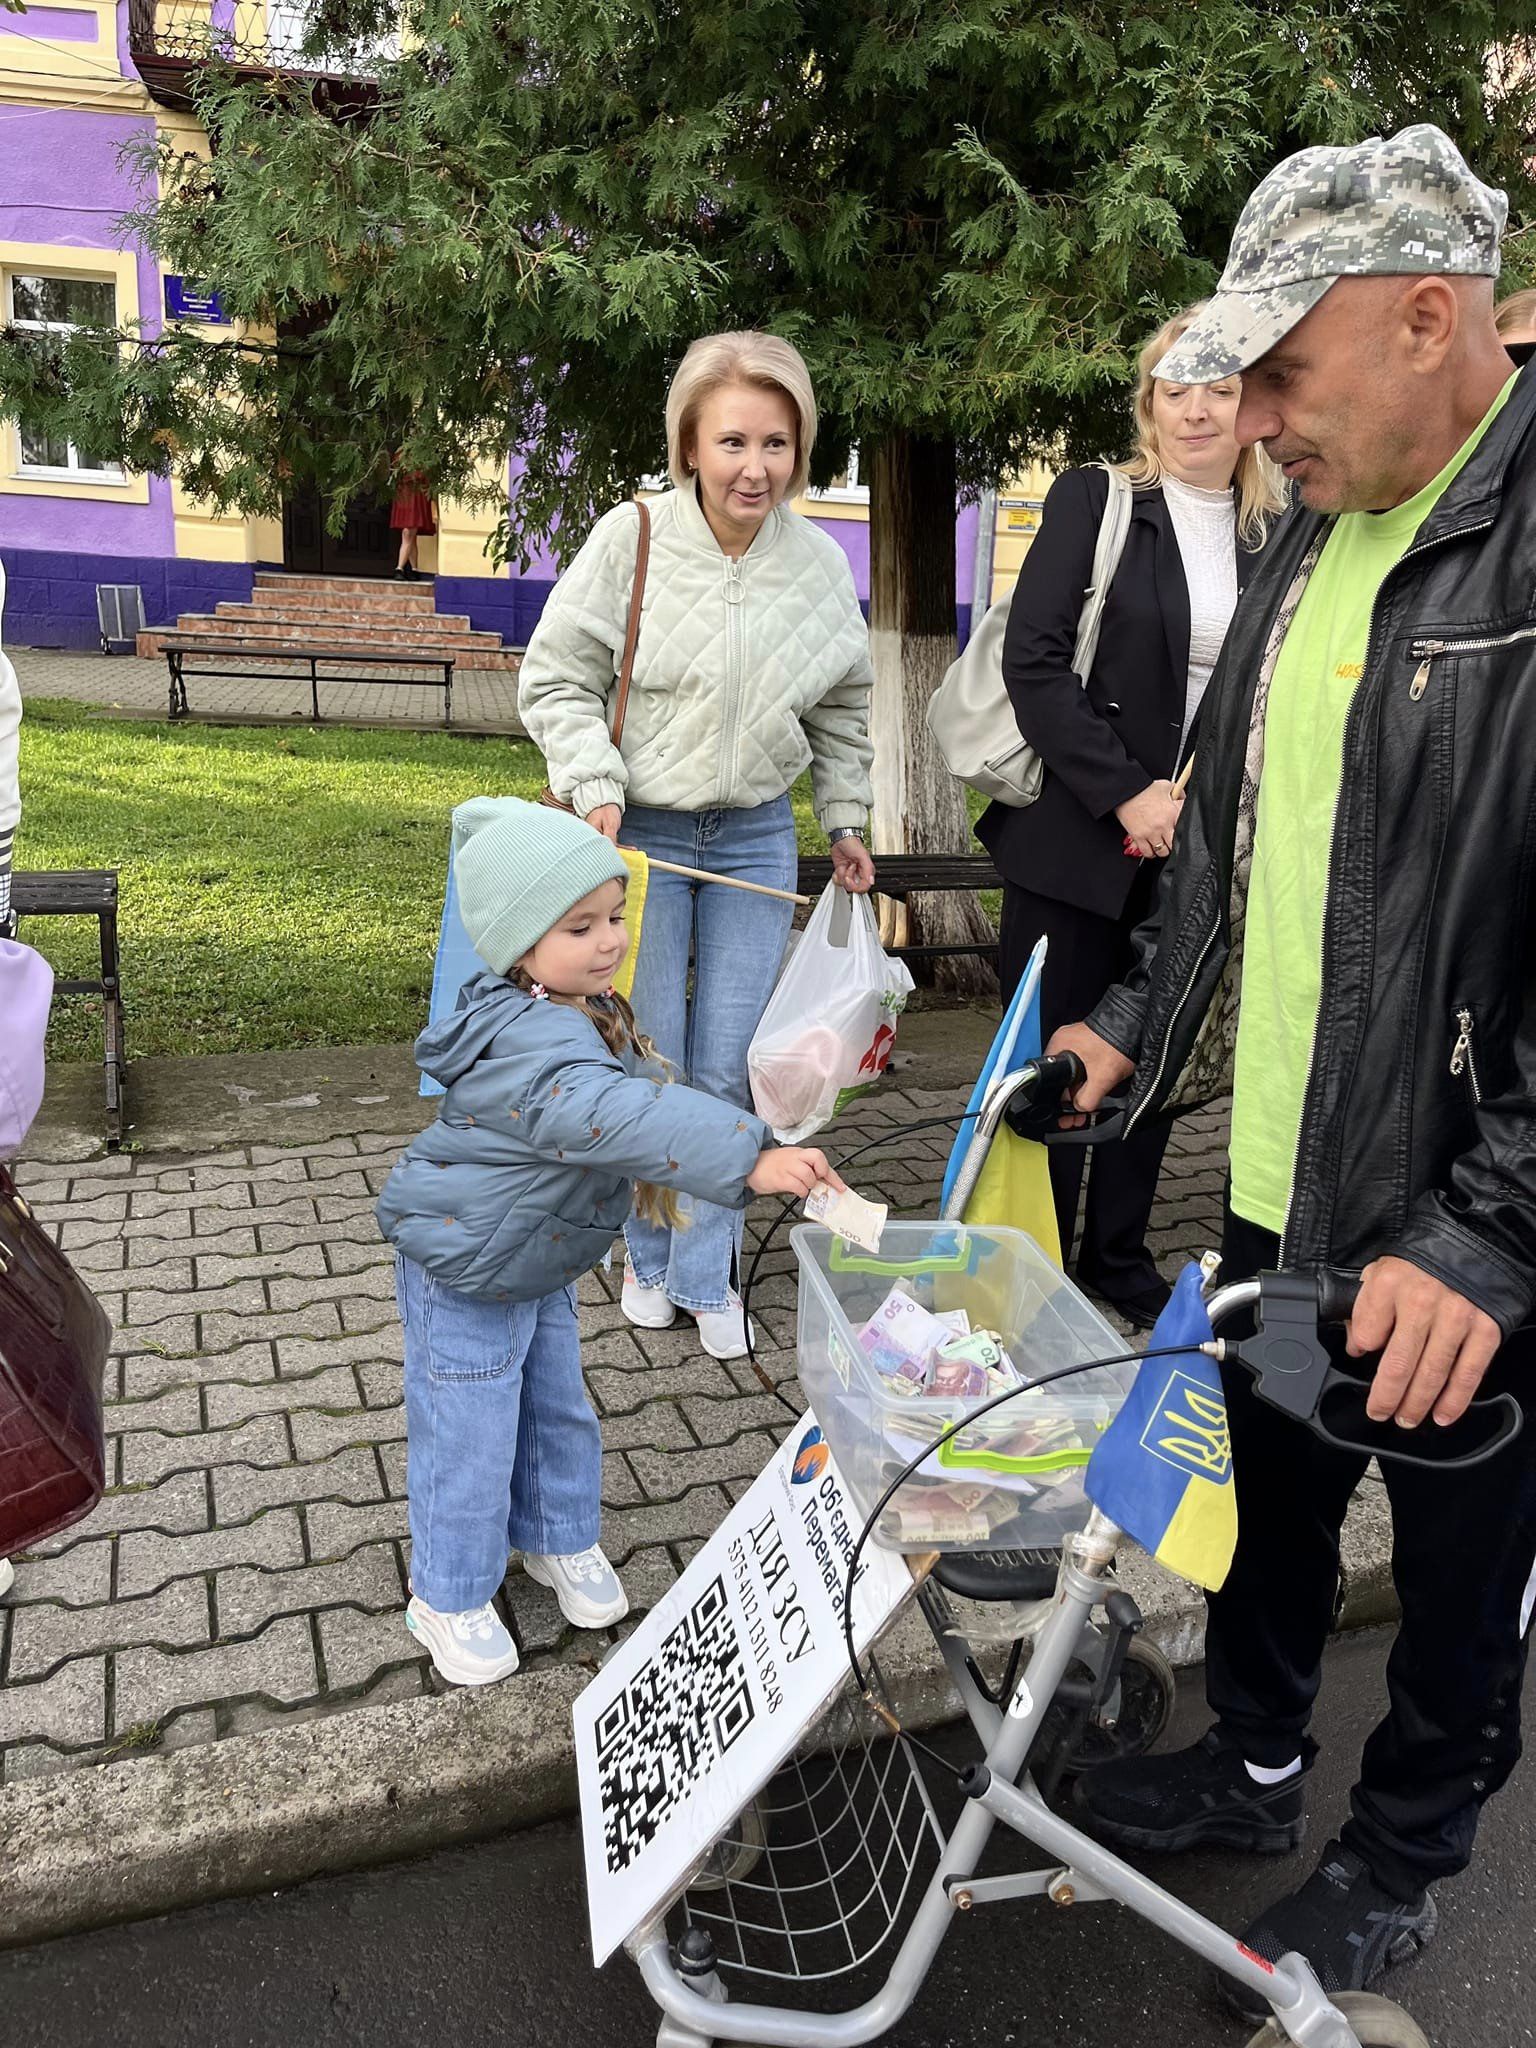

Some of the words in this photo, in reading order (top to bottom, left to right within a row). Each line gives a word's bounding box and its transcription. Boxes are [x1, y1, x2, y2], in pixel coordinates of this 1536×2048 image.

[839, 1227, 861, 1242] 500
[884, 1300, 902, 1319] 50
[981, 1347, 996, 1364] 20
[748, 1507, 790, 1595] ДЛЯ
[773, 1582, 816, 1663] ЗСУ
[727, 1537, 747, 1579] 5375
[738, 1579, 759, 1622] 4112
[749, 1624, 769, 1665] 1311
[759, 1661, 783, 1714] 8248
